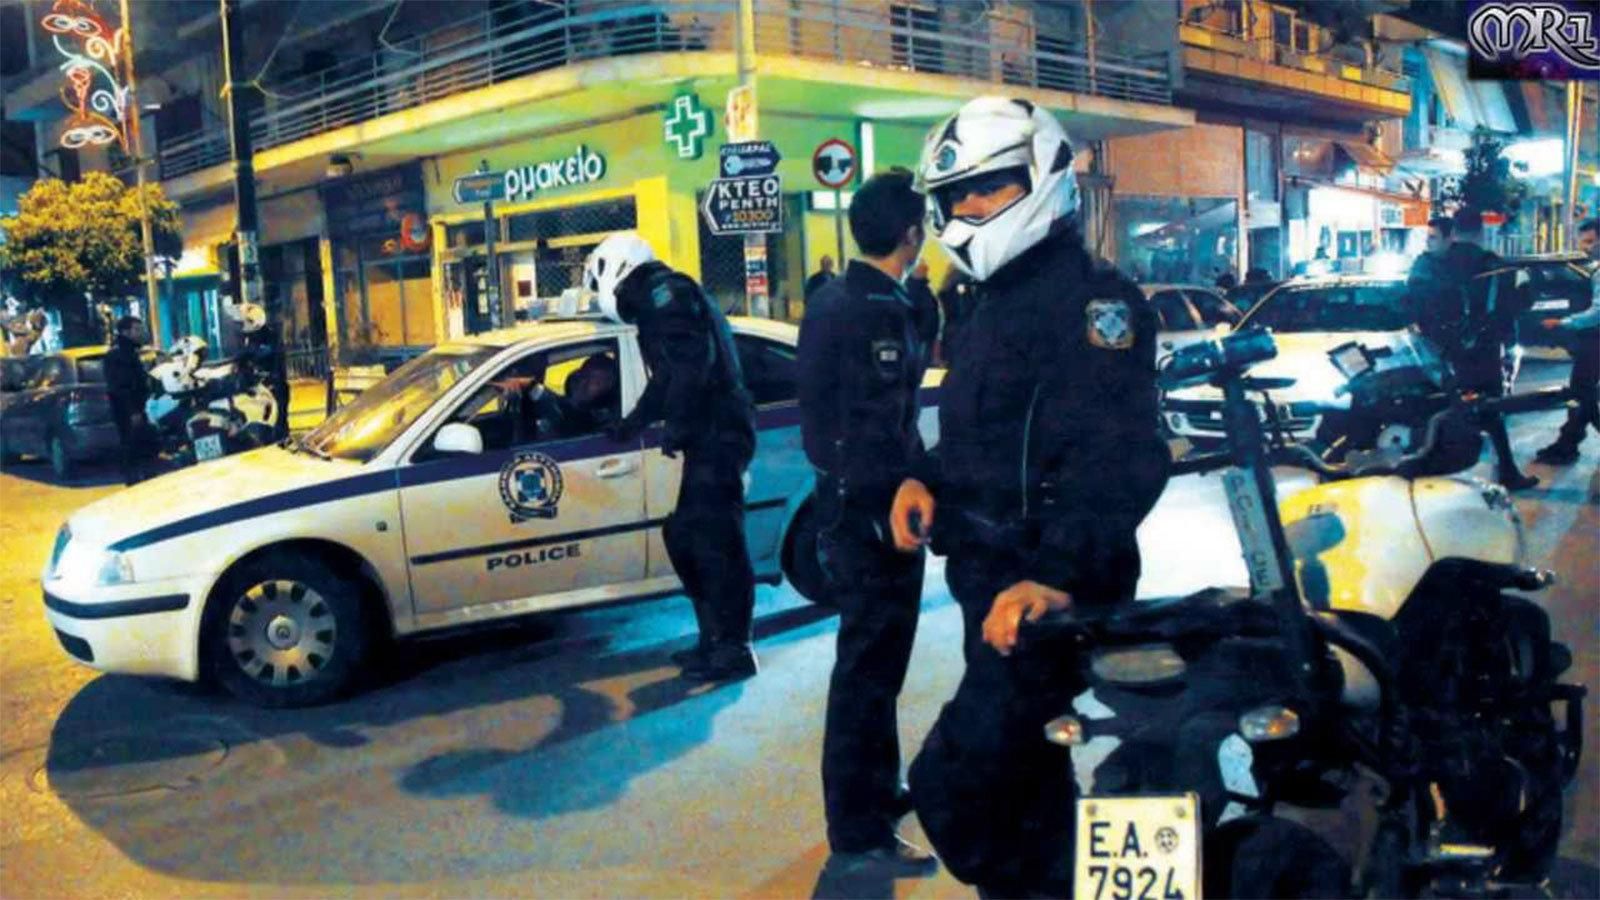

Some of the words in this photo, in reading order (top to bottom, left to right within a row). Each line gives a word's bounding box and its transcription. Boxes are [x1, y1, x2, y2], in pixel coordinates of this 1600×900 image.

[505, 145, 603, 201] ρμακείο
[718, 179, 779, 198] ΚΤΕΟ
[486, 543, 581, 571] POLICE
[1088, 865, 1185, 900] 7924
